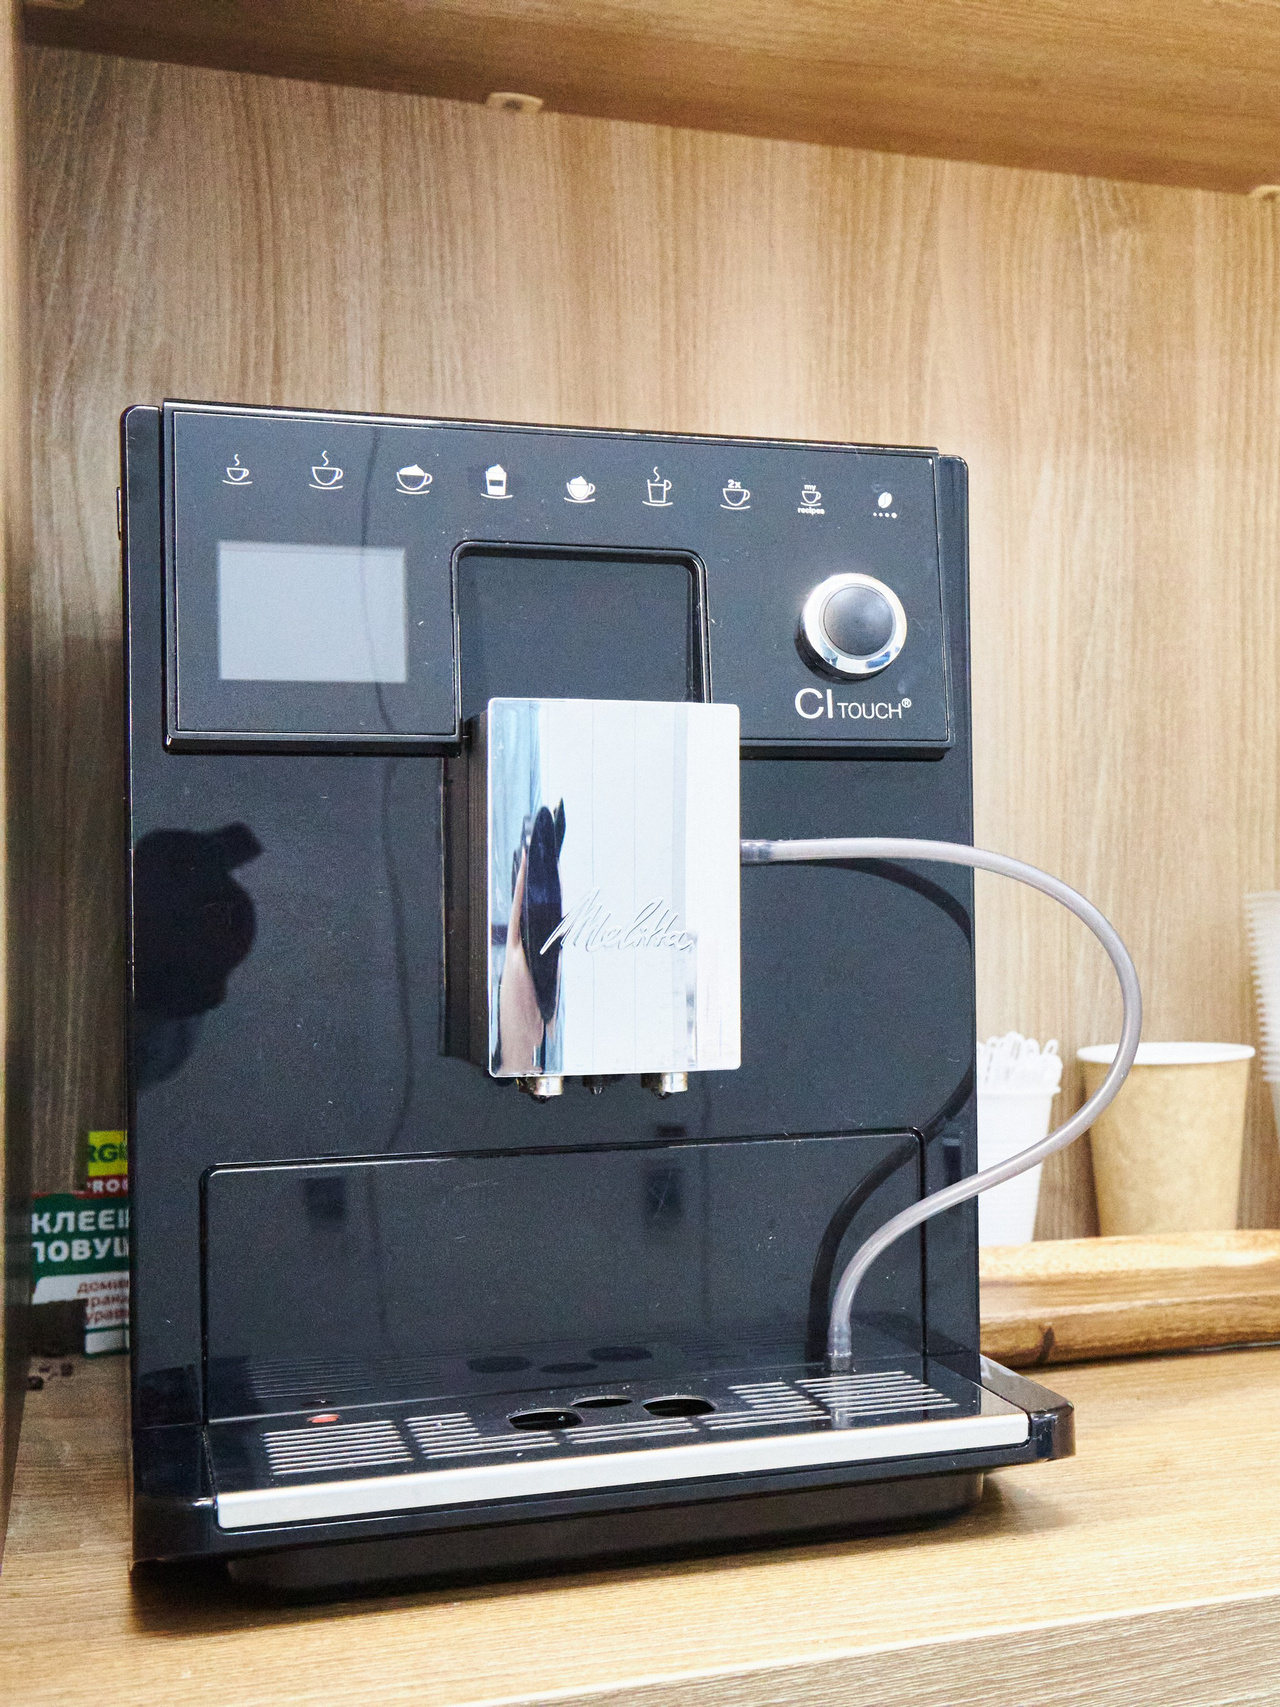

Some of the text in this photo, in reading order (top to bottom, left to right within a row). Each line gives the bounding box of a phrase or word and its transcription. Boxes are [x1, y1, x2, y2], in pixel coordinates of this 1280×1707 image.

[727, 479, 742, 489] 2x
[539, 886, 697, 956] Melitta
[31, 1207, 129, 1235] КЛЕЕ
